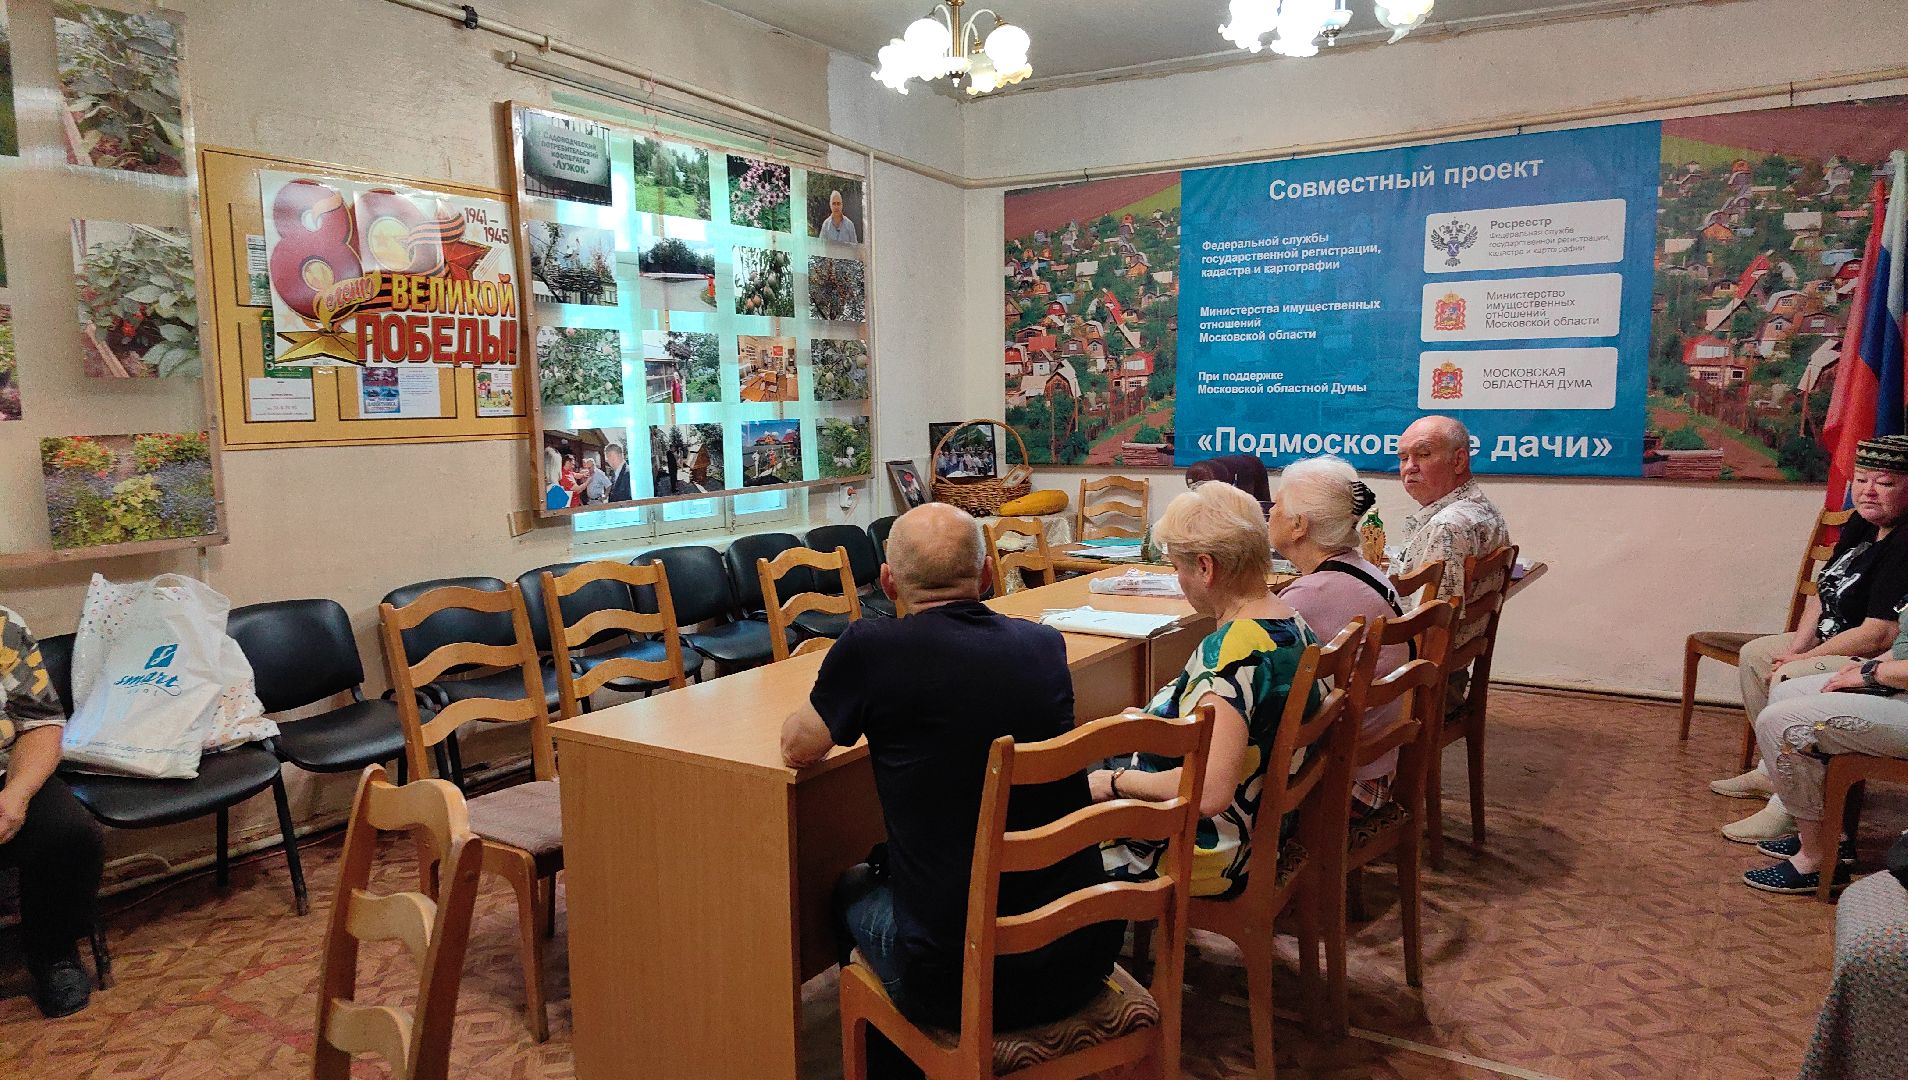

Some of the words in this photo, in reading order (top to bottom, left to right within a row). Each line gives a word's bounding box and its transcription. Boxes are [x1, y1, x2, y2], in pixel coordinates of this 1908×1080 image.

[1269, 165, 1435, 200] Совместный
[1444, 159, 1544, 188] проект
[464, 207, 487, 225] 1941
[1490, 218, 1552, 230] Росреестр
[483, 227, 510, 245] 1945
[1202, 236, 1279, 252] Федеральной
[1282, 233, 1329, 247] службы
[1201, 248, 1299, 265] государственной
[1301, 244, 1382, 259] регистрации,
[1201, 266, 1251, 278] кадастра
[1253, 266, 1261, 274] и
[1264, 260, 1340, 274] картографии
[391, 274, 517, 318] ВЕЛИКОЙ
[1486, 290, 1566, 300] Министерство
[1200, 305, 1280, 317] Министерства
[1282, 300, 1381, 315] имущественных
[1486, 299, 1575, 310] имущественных
[1485, 309, 1546, 319] отношений
[1199, 318, 1262, 330] отношений
[1485, 318, 1550, 329] Московской
[1553, 316, 1600, 327] области
[355, 312, 518, 367] ПОБЕДЫ!
[1199, 330, 1266, 343] Московской
[1268, 329, 1317, 340] области
[1198, 371, 1220, 383] При
[1222, 372, 1284, 382] поддержке
[1483, 368, 1566, 378] МОСКОВСКАЯ
[1198, 383, 1264, 394] Московской
[1266, 382, 1329, 393] областной
[1331, 382, 1367, 395] Думы
[1482, 379, 1555, 390] ОБЛАСТНАЯ
[1557, 379, 1593, 391] ДУМА
[1197, 427, 1481, 458] «Подмоскове
[1491, 434, 1613, 458] дачи»
[114, 671, 178, 688] smart
